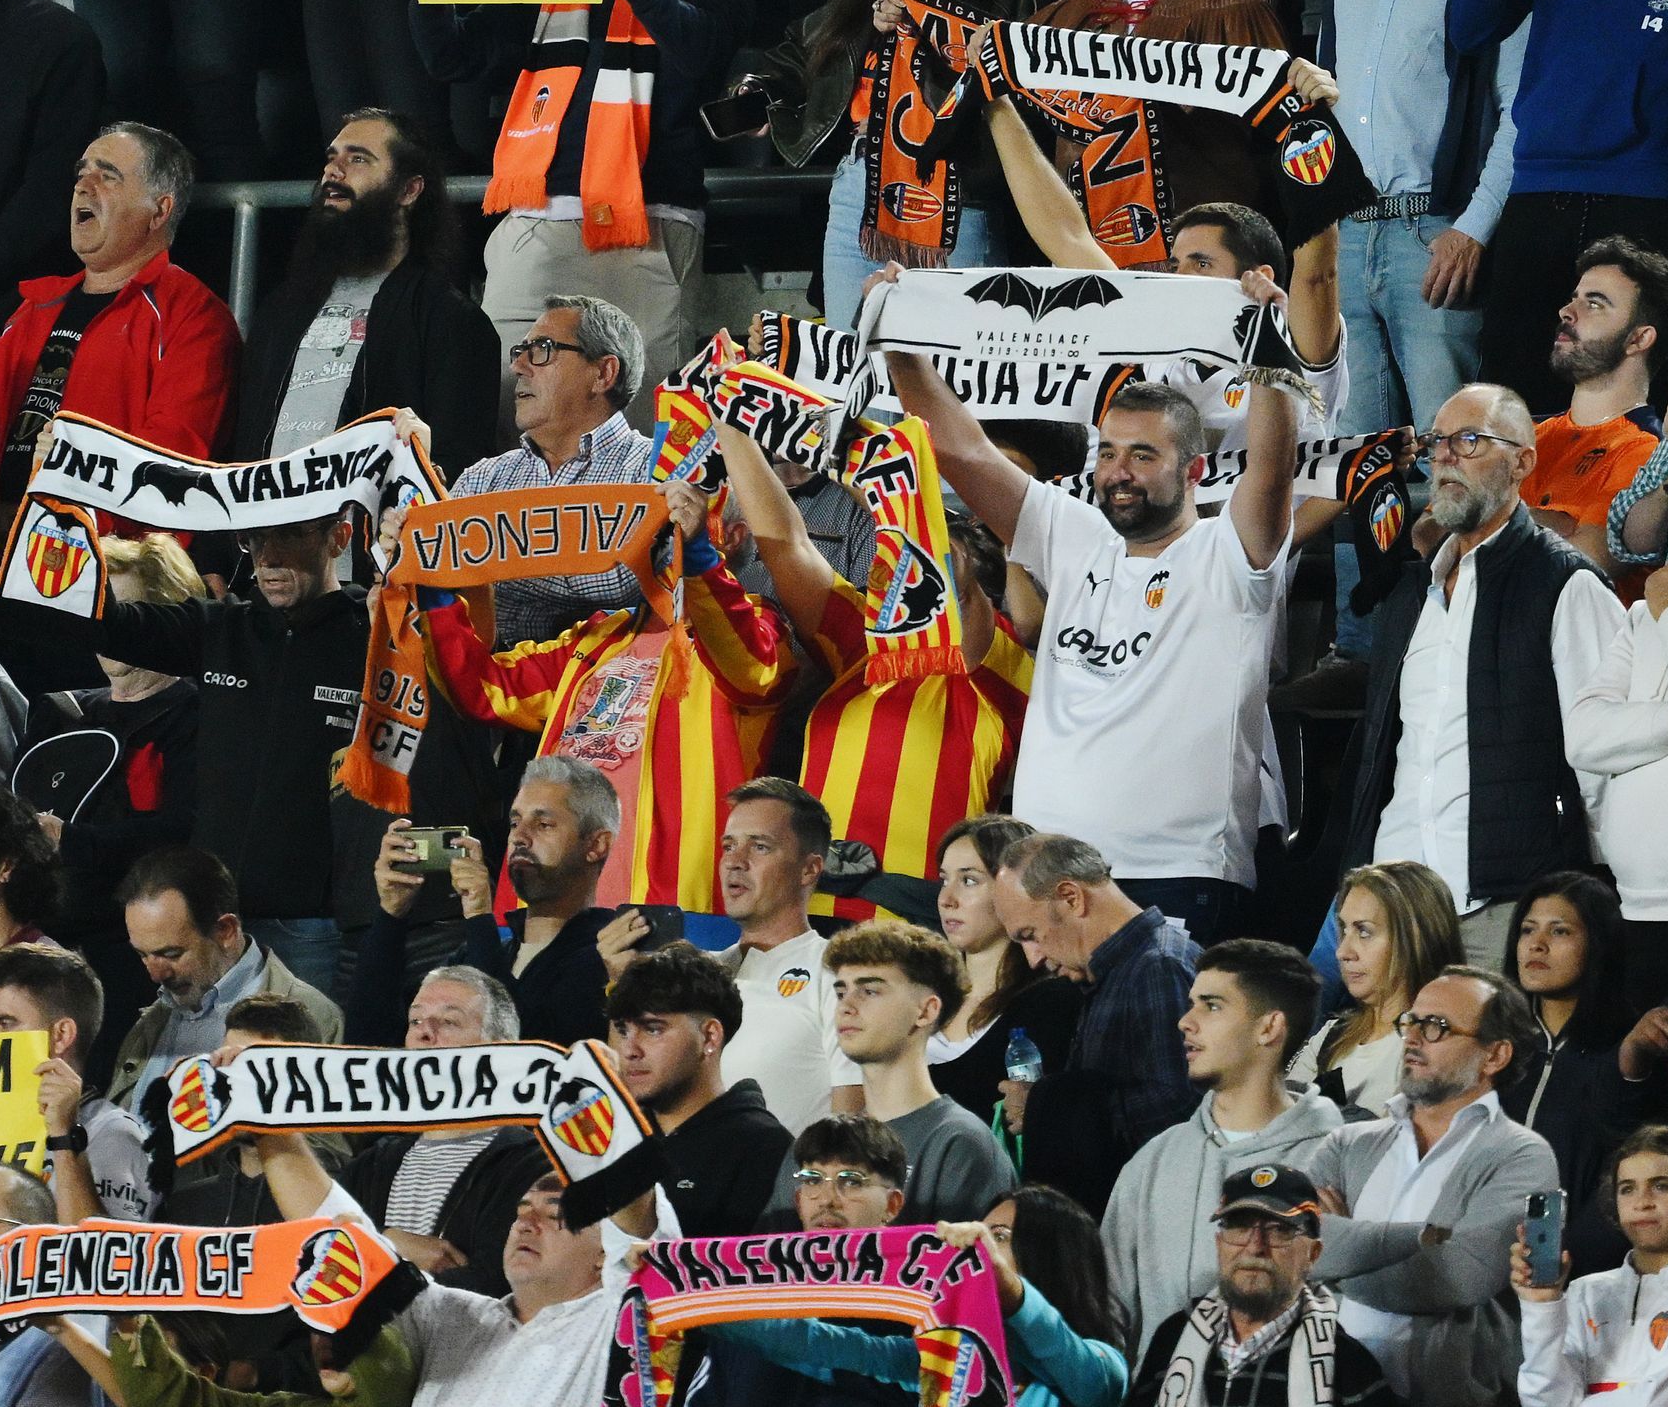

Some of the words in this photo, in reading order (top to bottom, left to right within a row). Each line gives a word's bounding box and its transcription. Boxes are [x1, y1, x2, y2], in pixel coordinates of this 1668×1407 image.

[1641, 14, 1664, 33] 14
[1016, 31, 1205, 90] VALENCIA
[1215, 45, 1270, 99] CF
[1043, 86, 1117, 122] Futbo
[943, 162, 957, 247] VALENCIA
[1154, 167, 1175, 244] 2003-200
[760, 309, 779, 370] AMUN
[43, 438, 120, 492] UNT
[1355, 445, 1393, 482] 1919
[413, 503, 647, 571] VALENCIA
[203, 671, 248, 689] CAZOO
[317, 687, 354, 703] VALENCIA
[245, 1054, 499, 1114] VALENCIA
[195, 1230, 257, 1298] CF
[641, 1233, 887, 1294] VALENCIA
